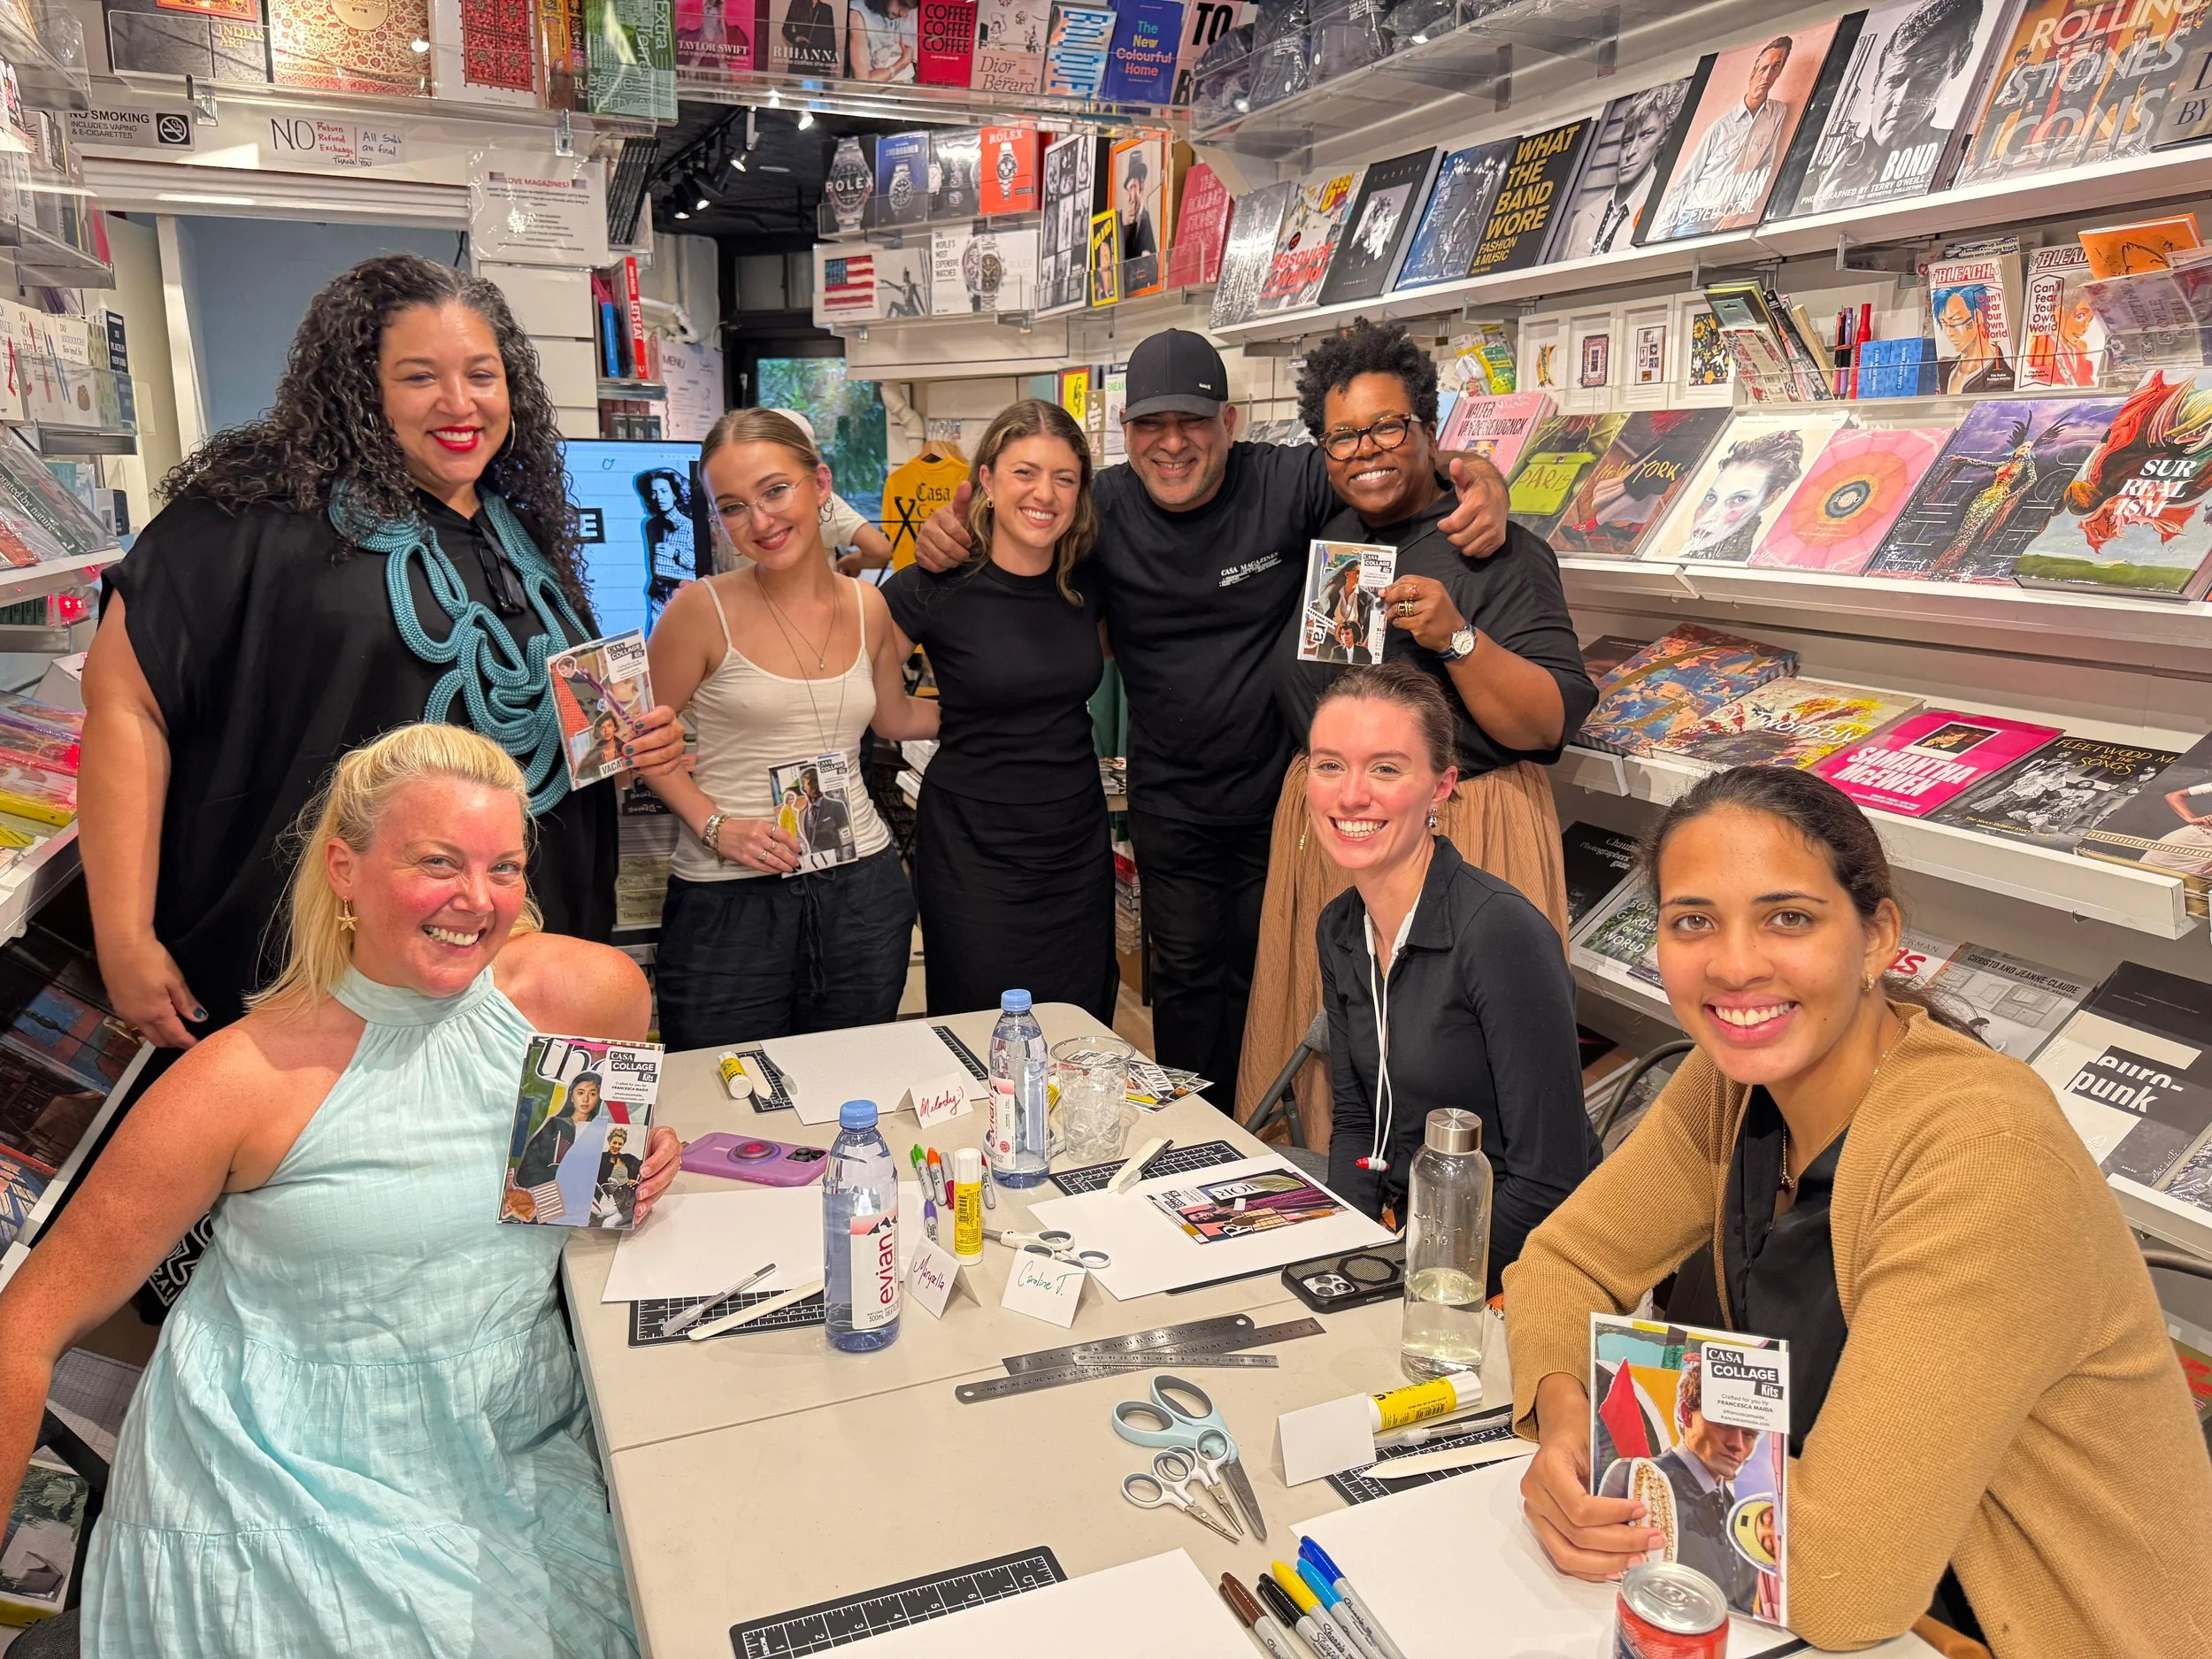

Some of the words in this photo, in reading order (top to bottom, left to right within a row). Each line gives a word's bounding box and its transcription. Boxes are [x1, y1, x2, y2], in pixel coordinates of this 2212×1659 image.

[925, 4, 972, 21] COFFEE
[924, 20, 970, 38] COFFEE
[1138, 21, 1158, 34] The
[219, 35, 246, 49] ART
[678, 40, 716, 52] TAYLOR
[718, 43, 749, 55] SWIFT
[923, 36, 968, 54] COFFEE
[1133, 35, 1158, 48] New
[773, 46, 840, 62] RIHANNA
[1116, 48, 1171, 64] Colourful
[978, 56, 1016, 73] Dior
[1125, 63, 1158, 76] Home
[2006, 32, 2184, 101] STONES
[982, 73, 1038, 93] Bérard
[71, 121, 108, 130] INCLUDES
[91, 111, 150, 124] SMOKING
[80, 129, 133, 139] E-CIGARETTES
[271, 119, 315, 150] NO
[317, 121, 343, 133] Return
[319, 134, 346, 144] Refund
[363, 132, 377, 142] All
[989, 130, 1023, 143] ROLEX
[1516, 125, 1580, 165] WHAT
[320, 144, 354, 157] Exchange
[378, 144, 396, 156] final
[1879, 142, 1939, 182] BOND
[1506, 158, 1547, 190] THE
[825, 176, 874, 193] ROLEX
[1870, 180, 1895, 192] TERRY
[1897, 177, 1925, 188] O'NEILL
[1494, 180, 1554, 216] BAND
[1486, 205, 1550, 241] WORE
[1479, 236, 1518, 255] FASHION
[1479, 250, 1509, 265] MUSIC
[1936, 264, 1994, 284] BLEACH
[2036, 294, 2057, 303] Fear
[2035, 304, 2056, 313] Your
[2032, 314, 2055, 323] Own
[1981, 330, 2008, 340] World
[2030, 322, 2057, 333] World
[1465, 401, 1496, 419] WALTER
[1632, 460, 1681, 484] YORK
[2139, 459, 2197, 477] SUR
[917, 483, 950, 502] Casa
[2118, 479, 2194, 498] REAL
[2116, 497, 2170, 518] ISM
[1220, 566, 1239, 576] CASA
[1240, 552, 1279, 571] MAGAZINES
[1751, 710, 1862, 744] Twombly
[2055, 738, 2153, 761] FLEETWOOD
[1847, 747, 1978, 784] SAMANTHA
[2080, 757, 2136, 776] SONGS
[1831, 763, 1940, 796] MCEWEN
[1632, 929, 1647, 938] THE
[1604, 932, 1645, 953] WORLD
[1967, 954, 1999, 970] CHRISTO
[1998, 963, 2016, 974] AND
[2016, 966, 2081, 995] JEANNE-CLAUDE
[611, 1052, 633, 1061] CASA
[2073, 1069, 2158, 1113] punk
[876, 1233, 894, 1304] evian
[1709, 1349, 1741, 1363] CASA
[1713, 1365, 1777, 1381] COLLAGE
[1761, 1383, 1778, 1398] Kits
[1717, 1400, 1752, 1409] FRANCESCA
